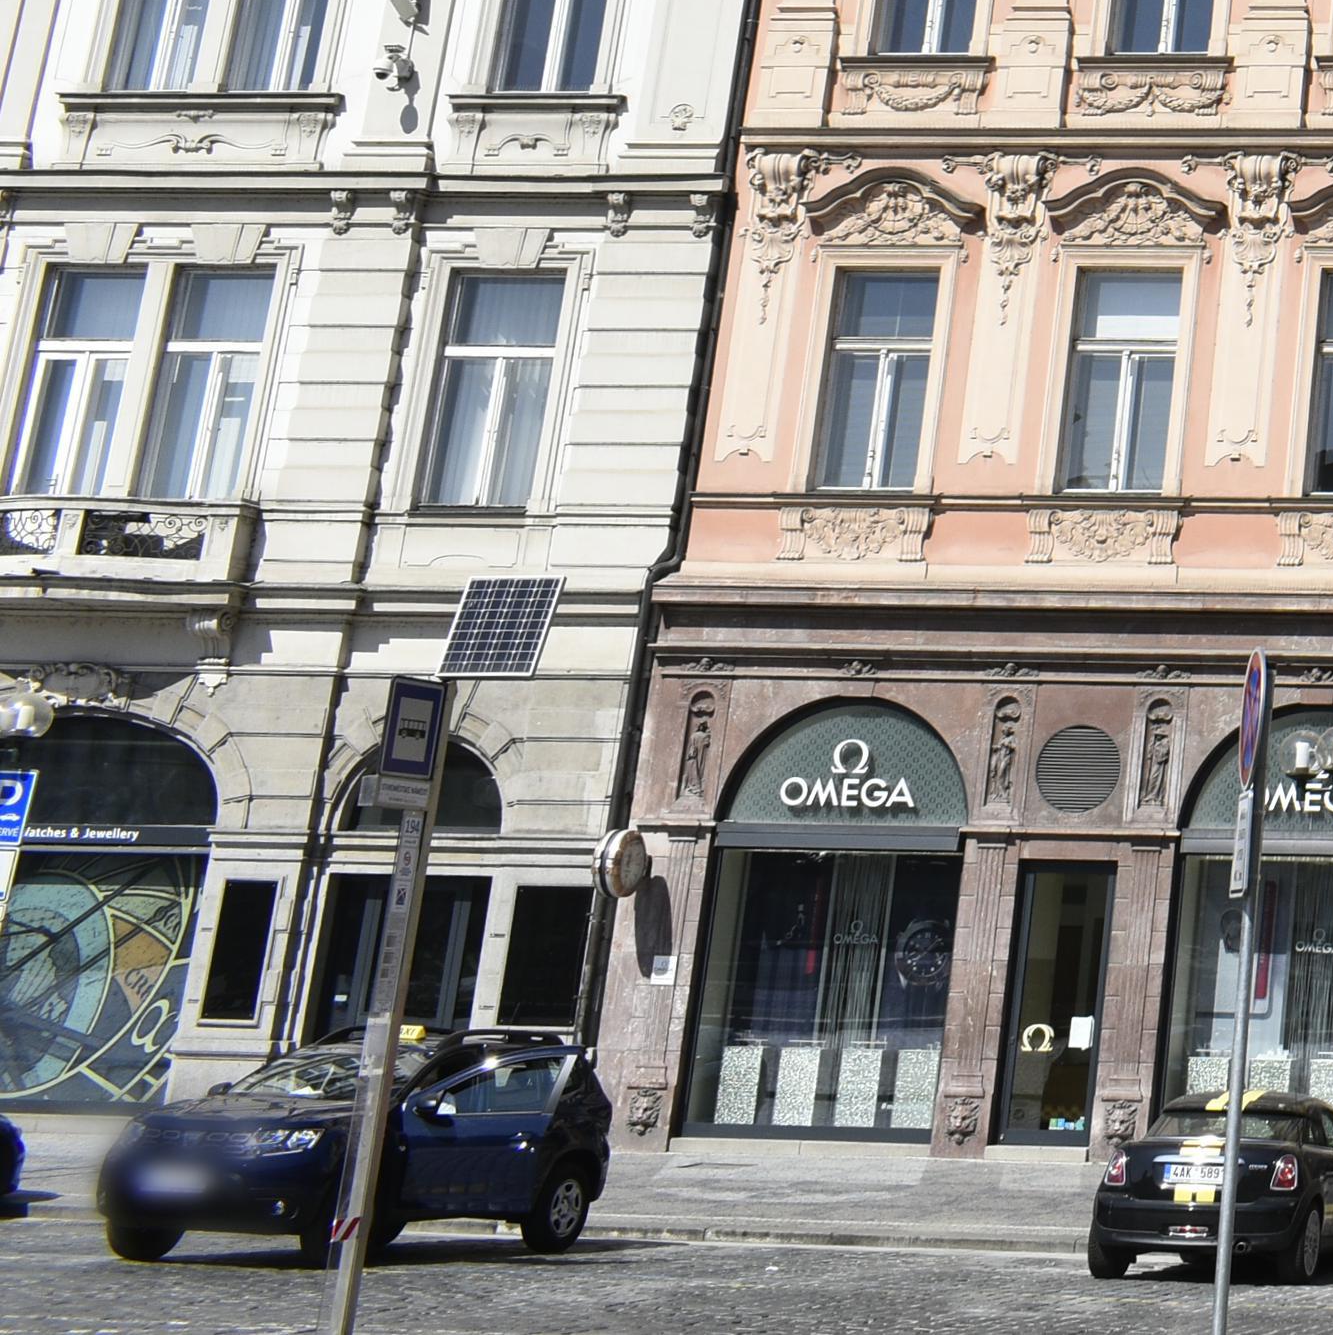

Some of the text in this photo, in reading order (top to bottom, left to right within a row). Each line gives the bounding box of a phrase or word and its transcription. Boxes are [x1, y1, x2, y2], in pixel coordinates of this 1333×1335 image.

[780, 777, 915, 808] OMEGA
[24, 827, 139, 841] atches & Jewellery
[833, 933, 878, 944] OMEGA
[1172, 1168, 1224, 1179] 4AK 589
